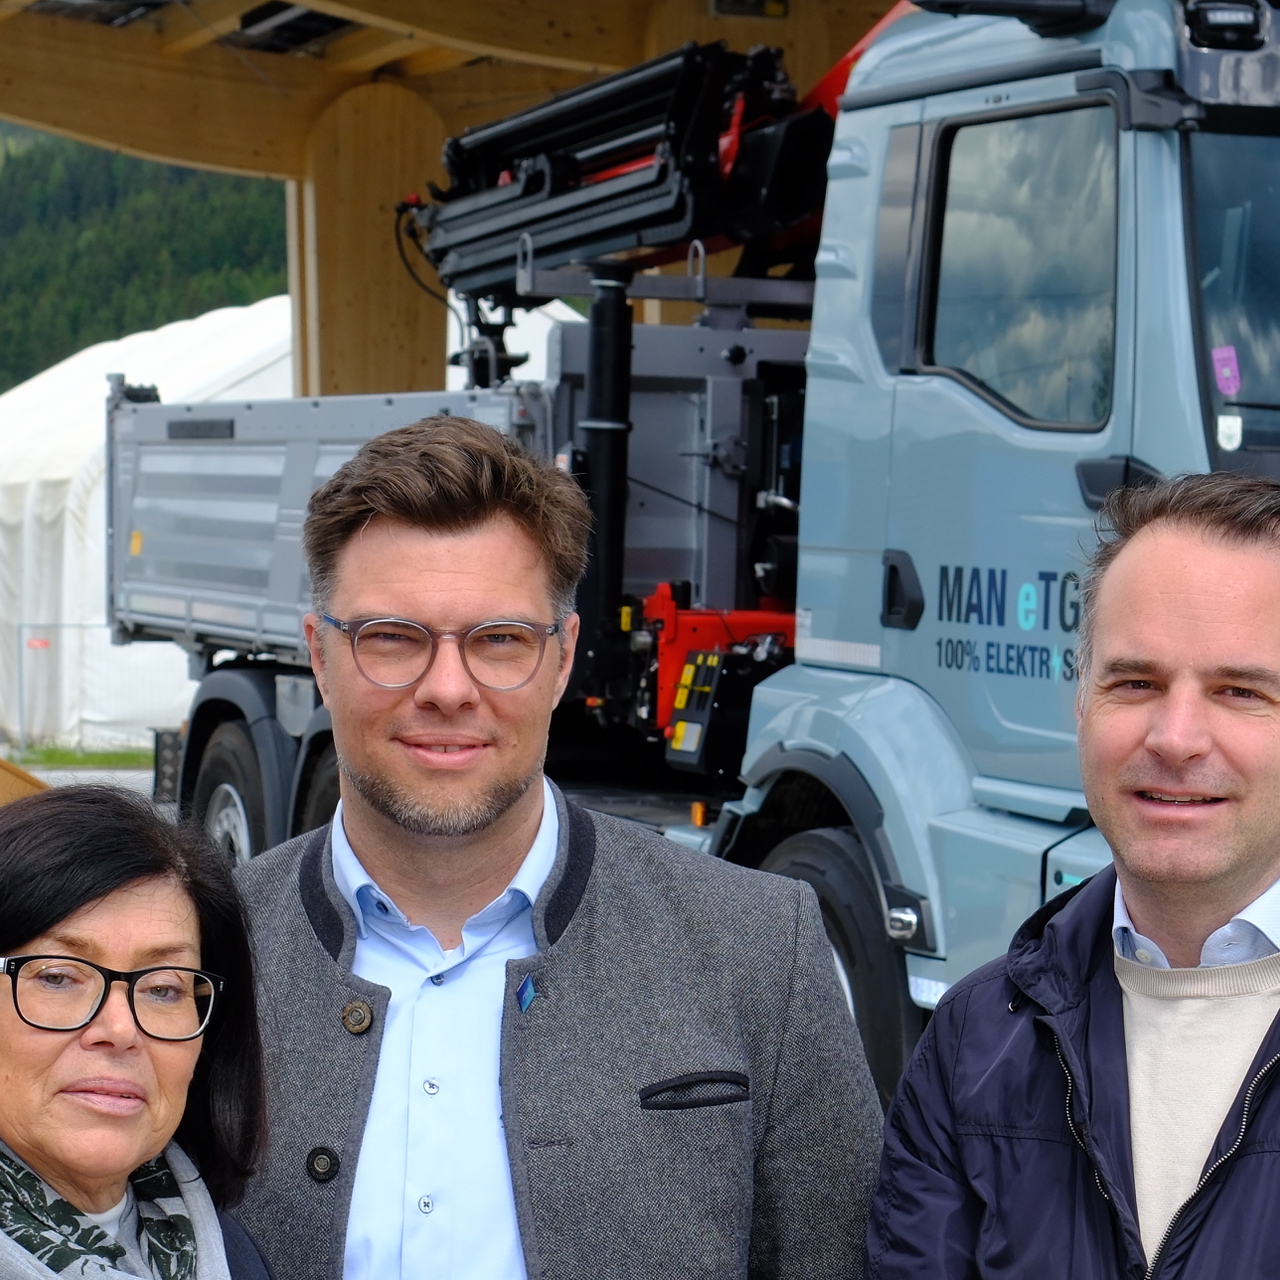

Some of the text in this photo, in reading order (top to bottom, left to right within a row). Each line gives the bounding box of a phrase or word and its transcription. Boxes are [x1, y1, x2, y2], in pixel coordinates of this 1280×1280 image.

[937, 565, 1081, 633] MAN eTG
[936, 637, 981, 672] 100%
